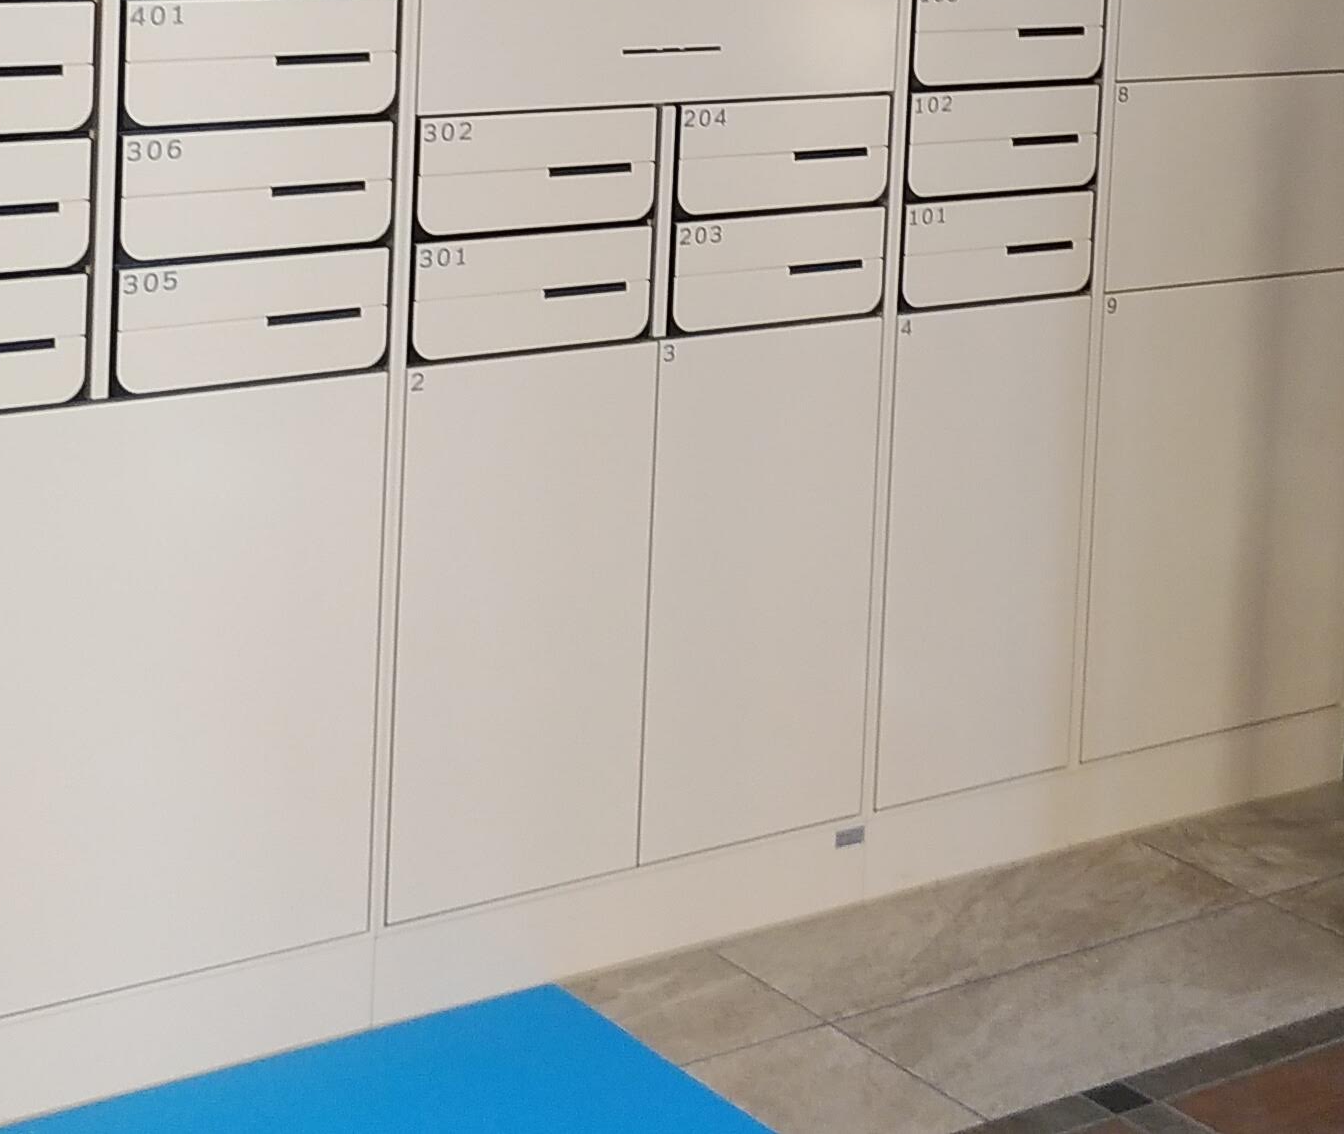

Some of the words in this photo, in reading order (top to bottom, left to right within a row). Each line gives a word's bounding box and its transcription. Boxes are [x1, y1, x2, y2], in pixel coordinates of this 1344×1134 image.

[130, 6, 184, 26] 401
[1119, 86, 1128, 103] 8
[915, 96, 953, 114] 102
[685, 109, 726, 128] 204
[423, 122, 472, 143] 302
[127, 139, 182, 162] 306
[910, 207, 946, 226] 101
[680, 226, 722, 246] 203
[420, 248, 466, 268] 301
[123, 271, 178, 295] 305
[1107, 297, 1117, 314] 9
[901, 319, 911, 335] 4
[663, 344, 675, 362] 3
[411, 373, 424, 392] 2
